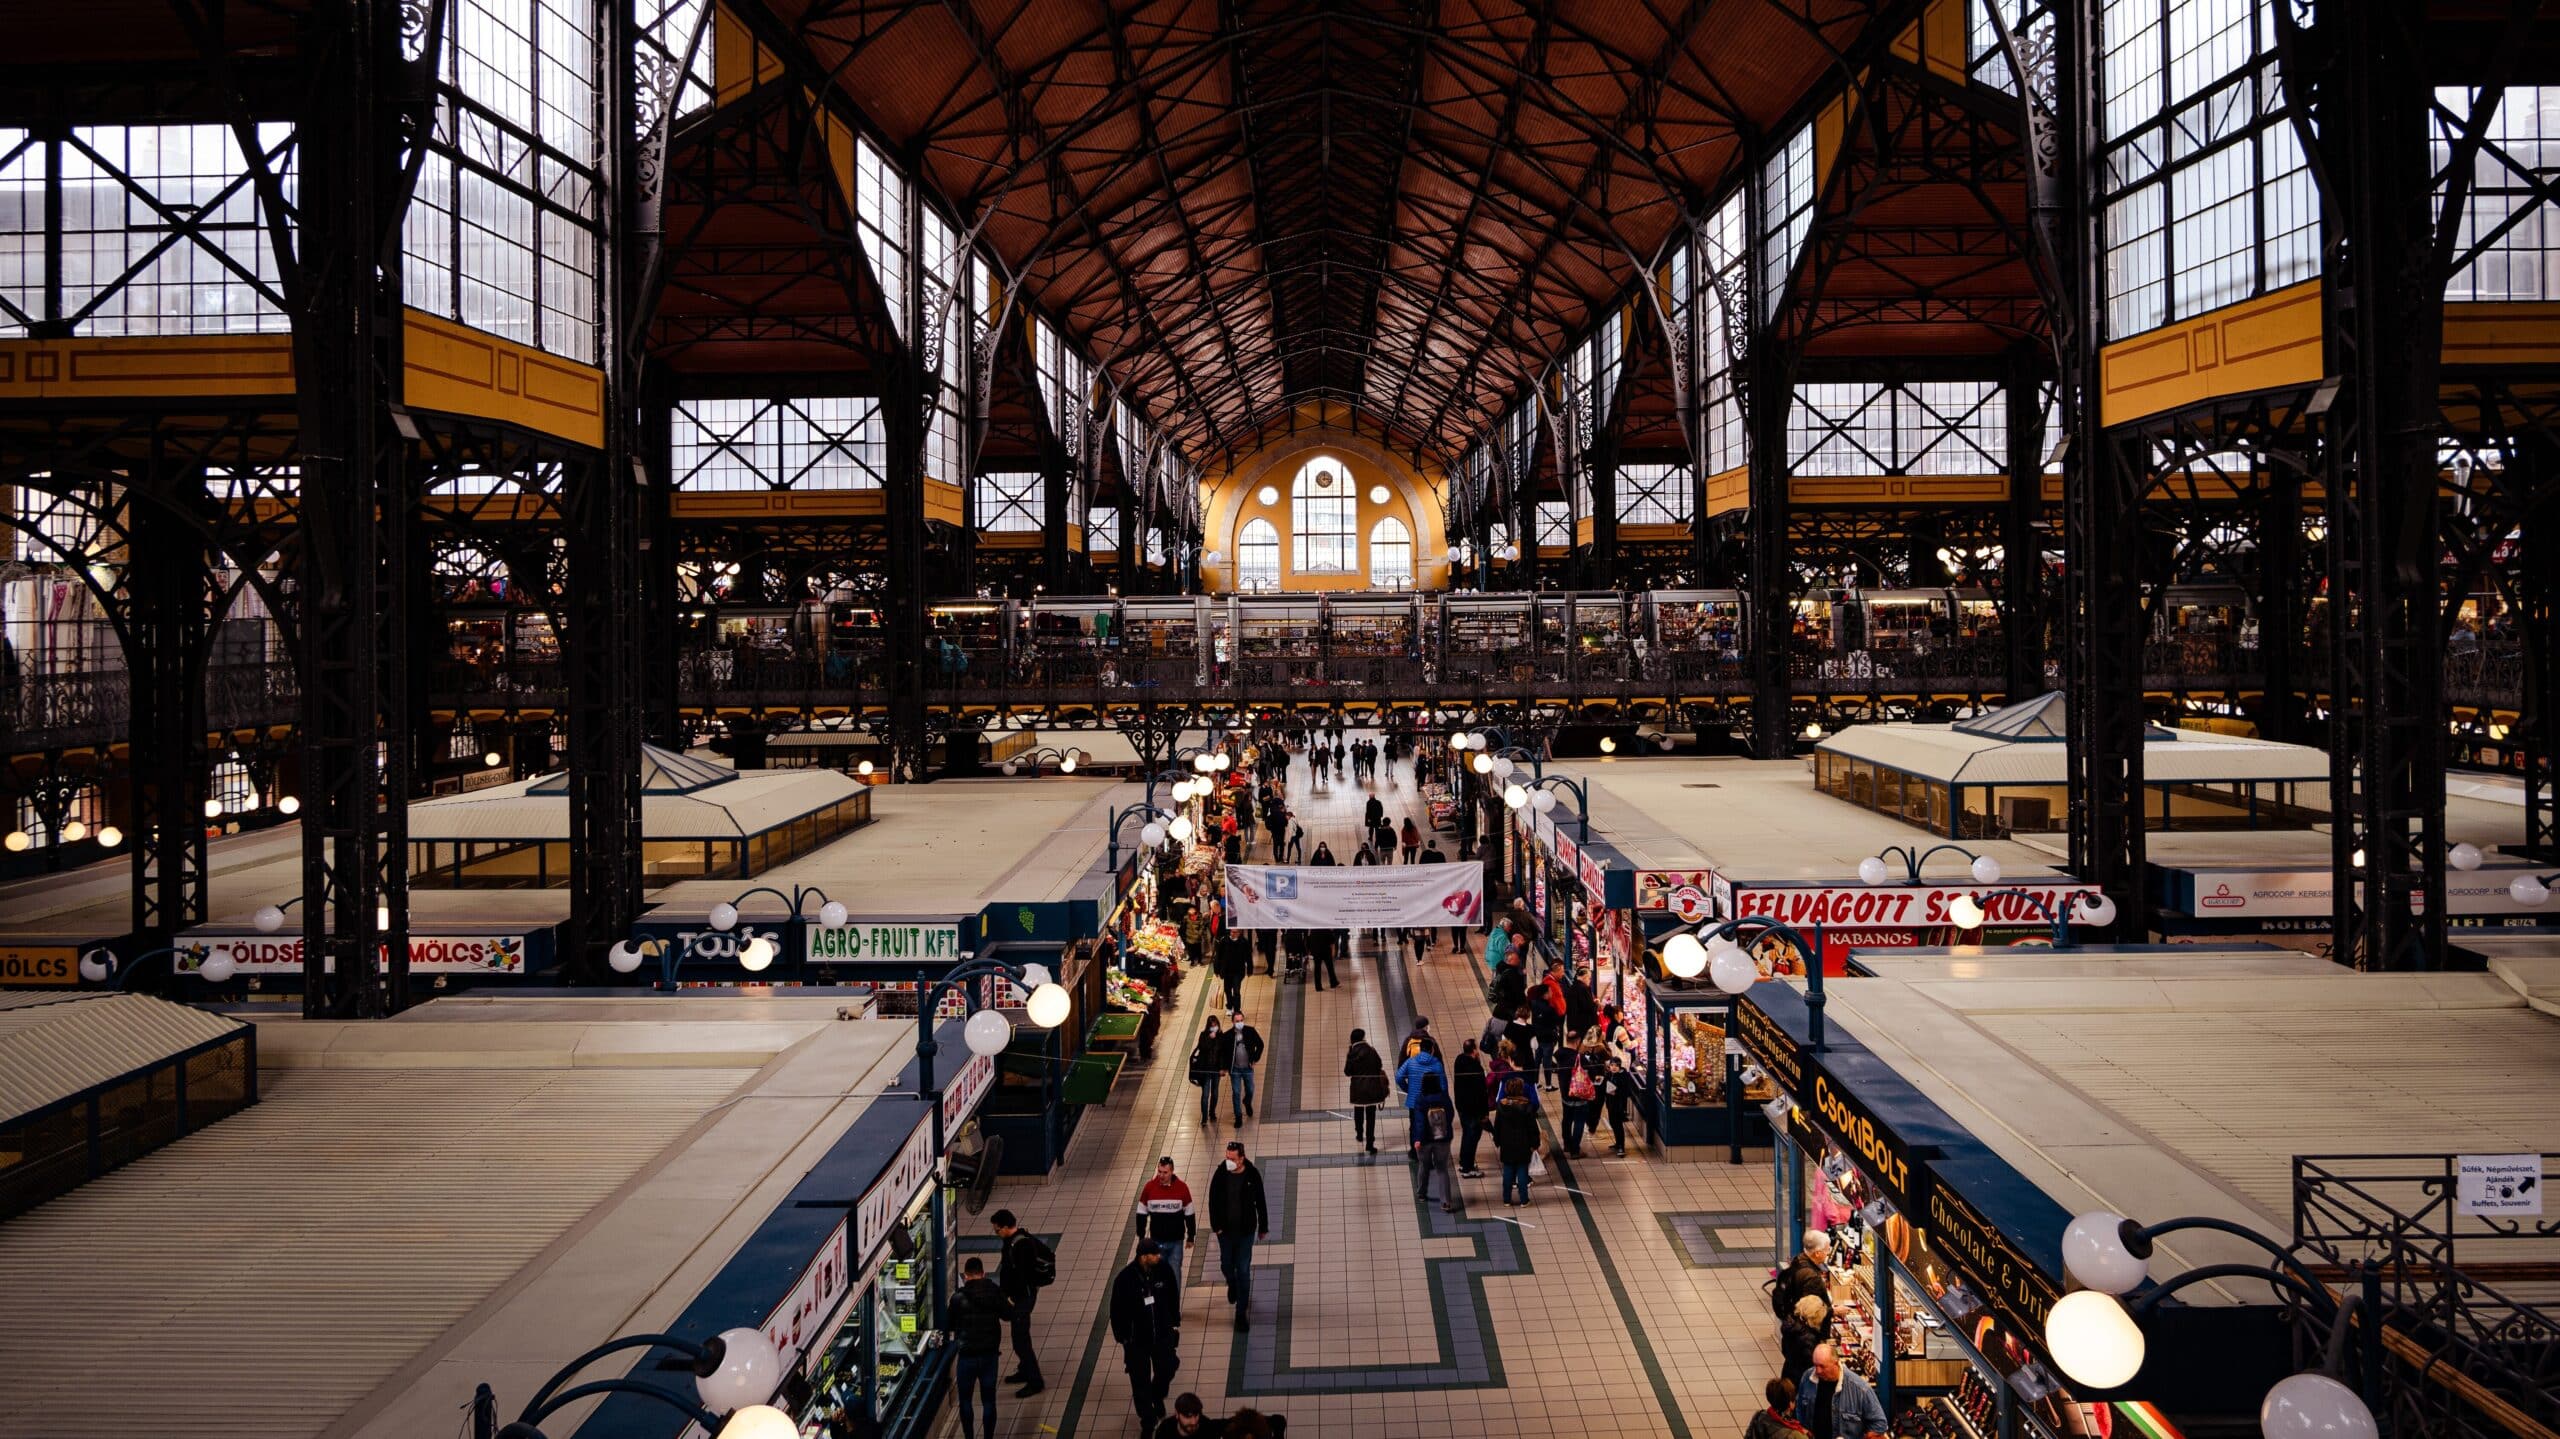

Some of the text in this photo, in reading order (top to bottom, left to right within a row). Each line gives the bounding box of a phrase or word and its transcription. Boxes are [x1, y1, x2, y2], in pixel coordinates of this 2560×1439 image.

[2253, 890, 2295, 898] AGROCORP
[1740, 889, 1914, 924] FELVÁGOTT
[811, 927, 959, 958] AGRO-FRUIT KFT.
[1829, 932, 1913, 945] KABANOS
[0, 953, 68, 977] ÖLCS
[2485, 1176, 2516, 1184] Ajándék
[2471, 1200, 2499, 1208] Buffets,
[1931, 1194, 1995, 1275] Chocolate
[2001, 1266, 2012, 1288] &
